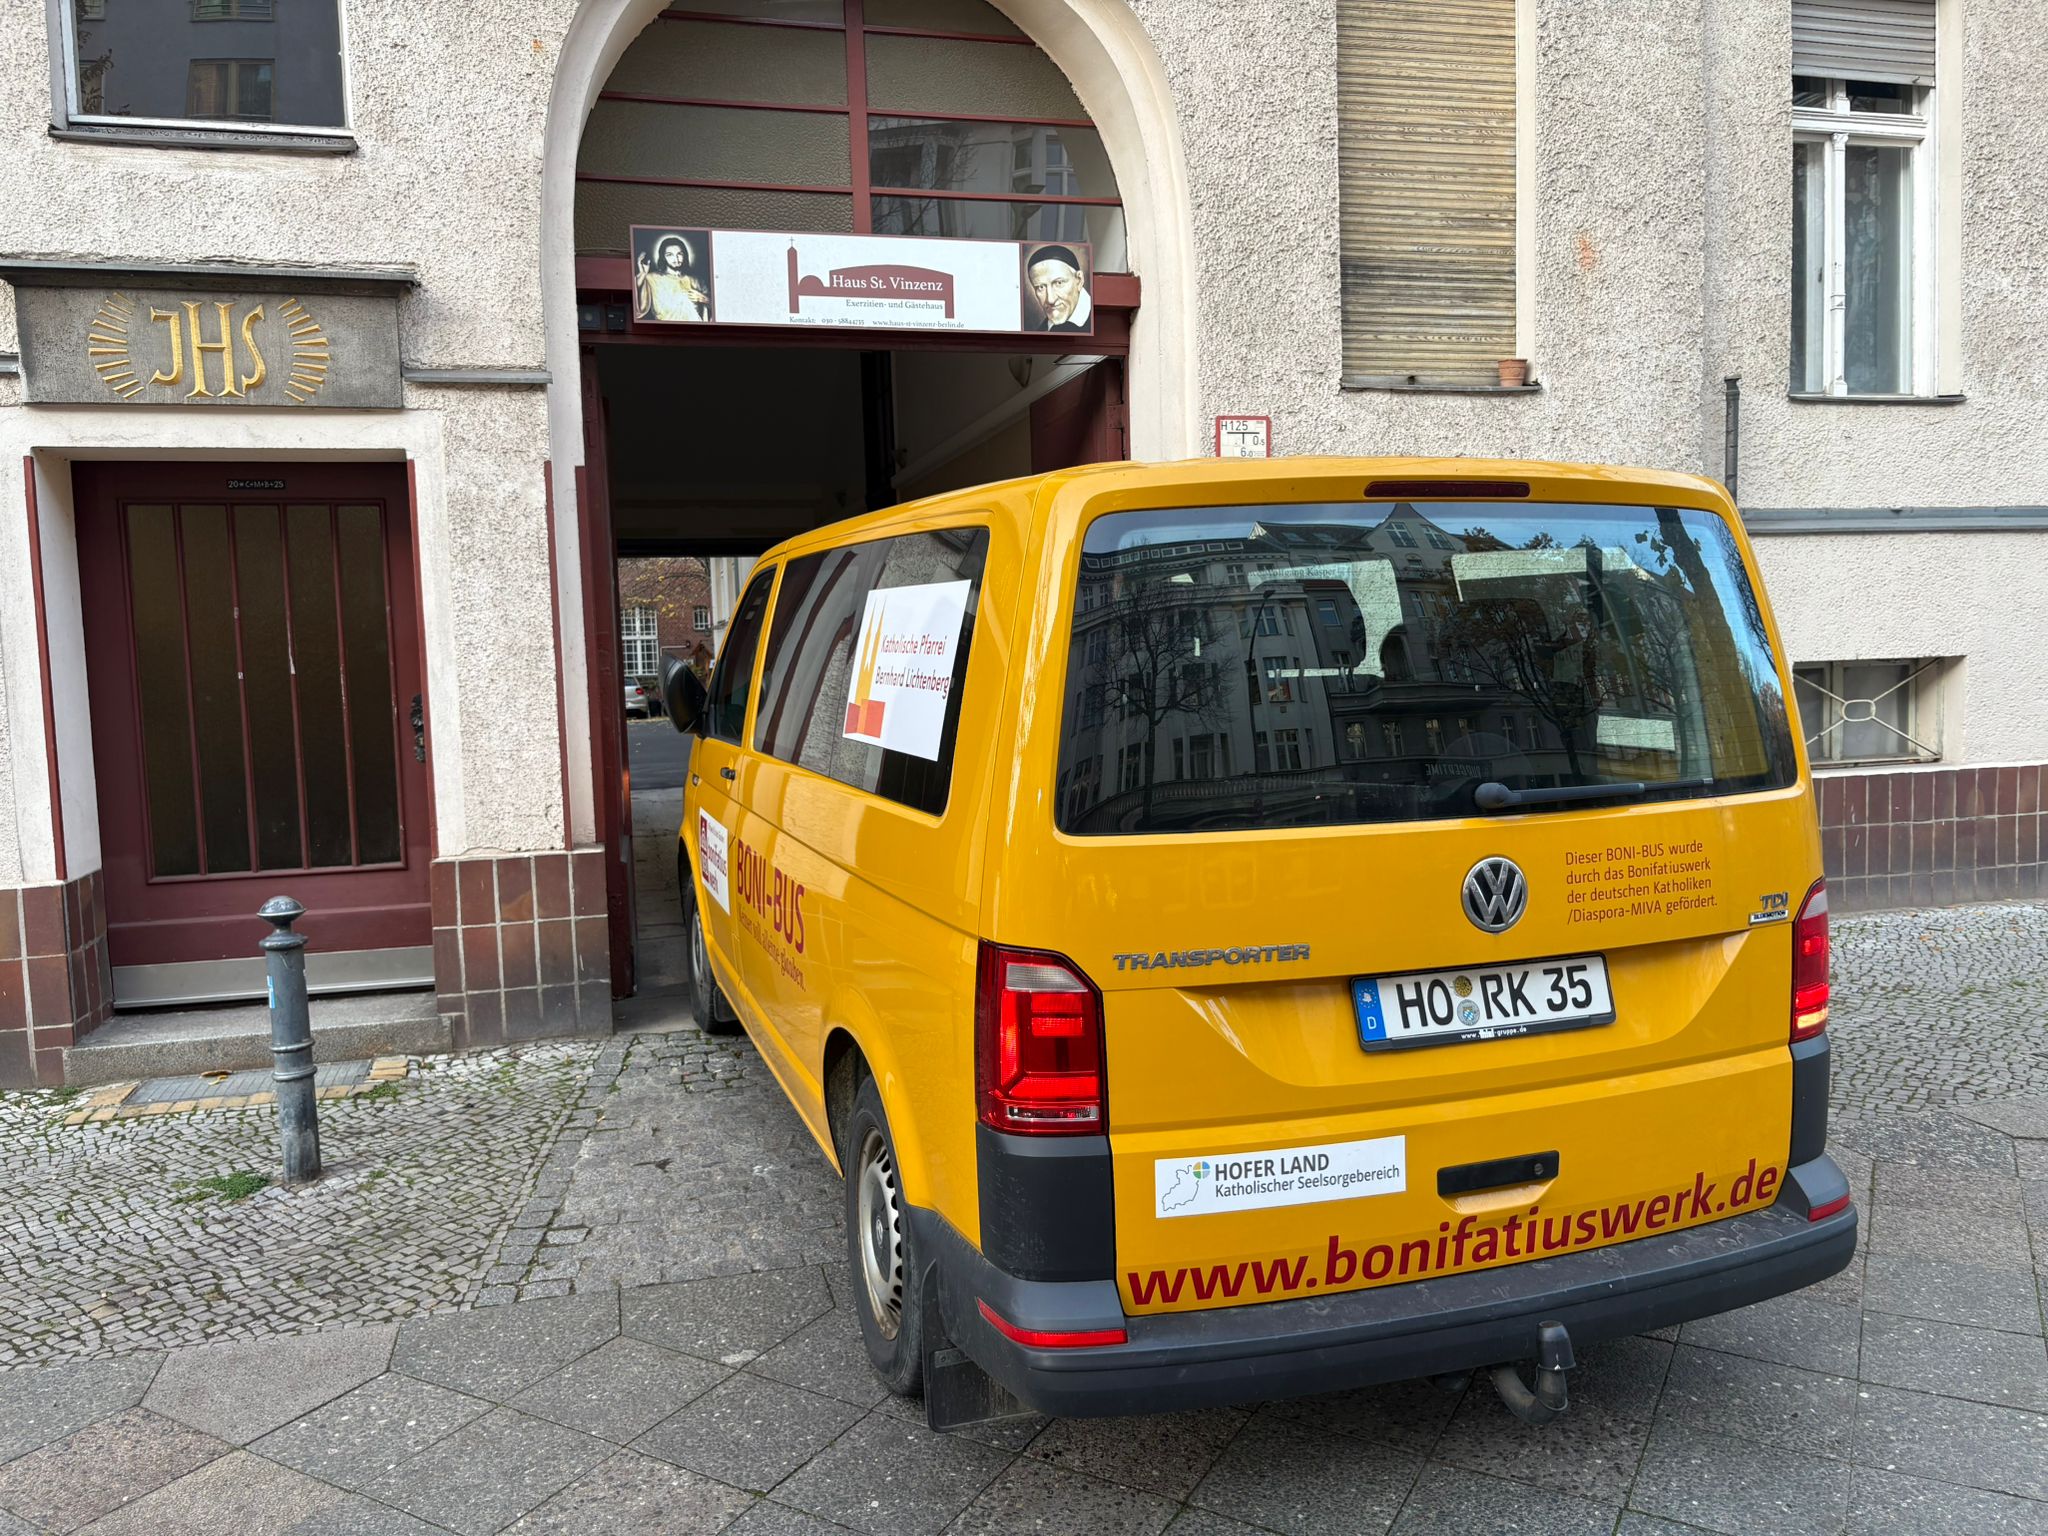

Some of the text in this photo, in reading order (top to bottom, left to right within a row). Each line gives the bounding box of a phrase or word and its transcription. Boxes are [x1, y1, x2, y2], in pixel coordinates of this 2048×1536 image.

[832, 274, 943, 291] Haus St. Vinzenz
[846, 299, 943, 310] Exerzitien- und Gästehaus
[147, 301, 266, 398] JHS
[881, 634, 948, 656] Katholische Pfarrei
[875, 666, 950, 700] Bernhard Lichtenberg
[1565, 840, 1703, 865] Dieser BONI-BUS wurde
[1566, 857, 1711, 885] durch das Bonifatiuswerk
[737, 839, 805, 954] BONI-BUS
[1567, 877, 1712, 904] der deutschen Katholiken
[1759, 891, 1788, 910] TDI
[1567, 894, 1718, 925] /Diaspora-MIVA gefördert.
[1113, 943, 1311, 970] TRANSPORTER
[1395, 964, 1593, 1029] HO RK 35
[1367, 1017, 1377, 1030] D
[1215, 1153, 1329, 1181] HOFER LAND
[1215, 1164, 1400, 1197] Katholischer Seelsorgebereich
[1127, 1158, 1778, 1306] www.bonifatiuswerk.de
